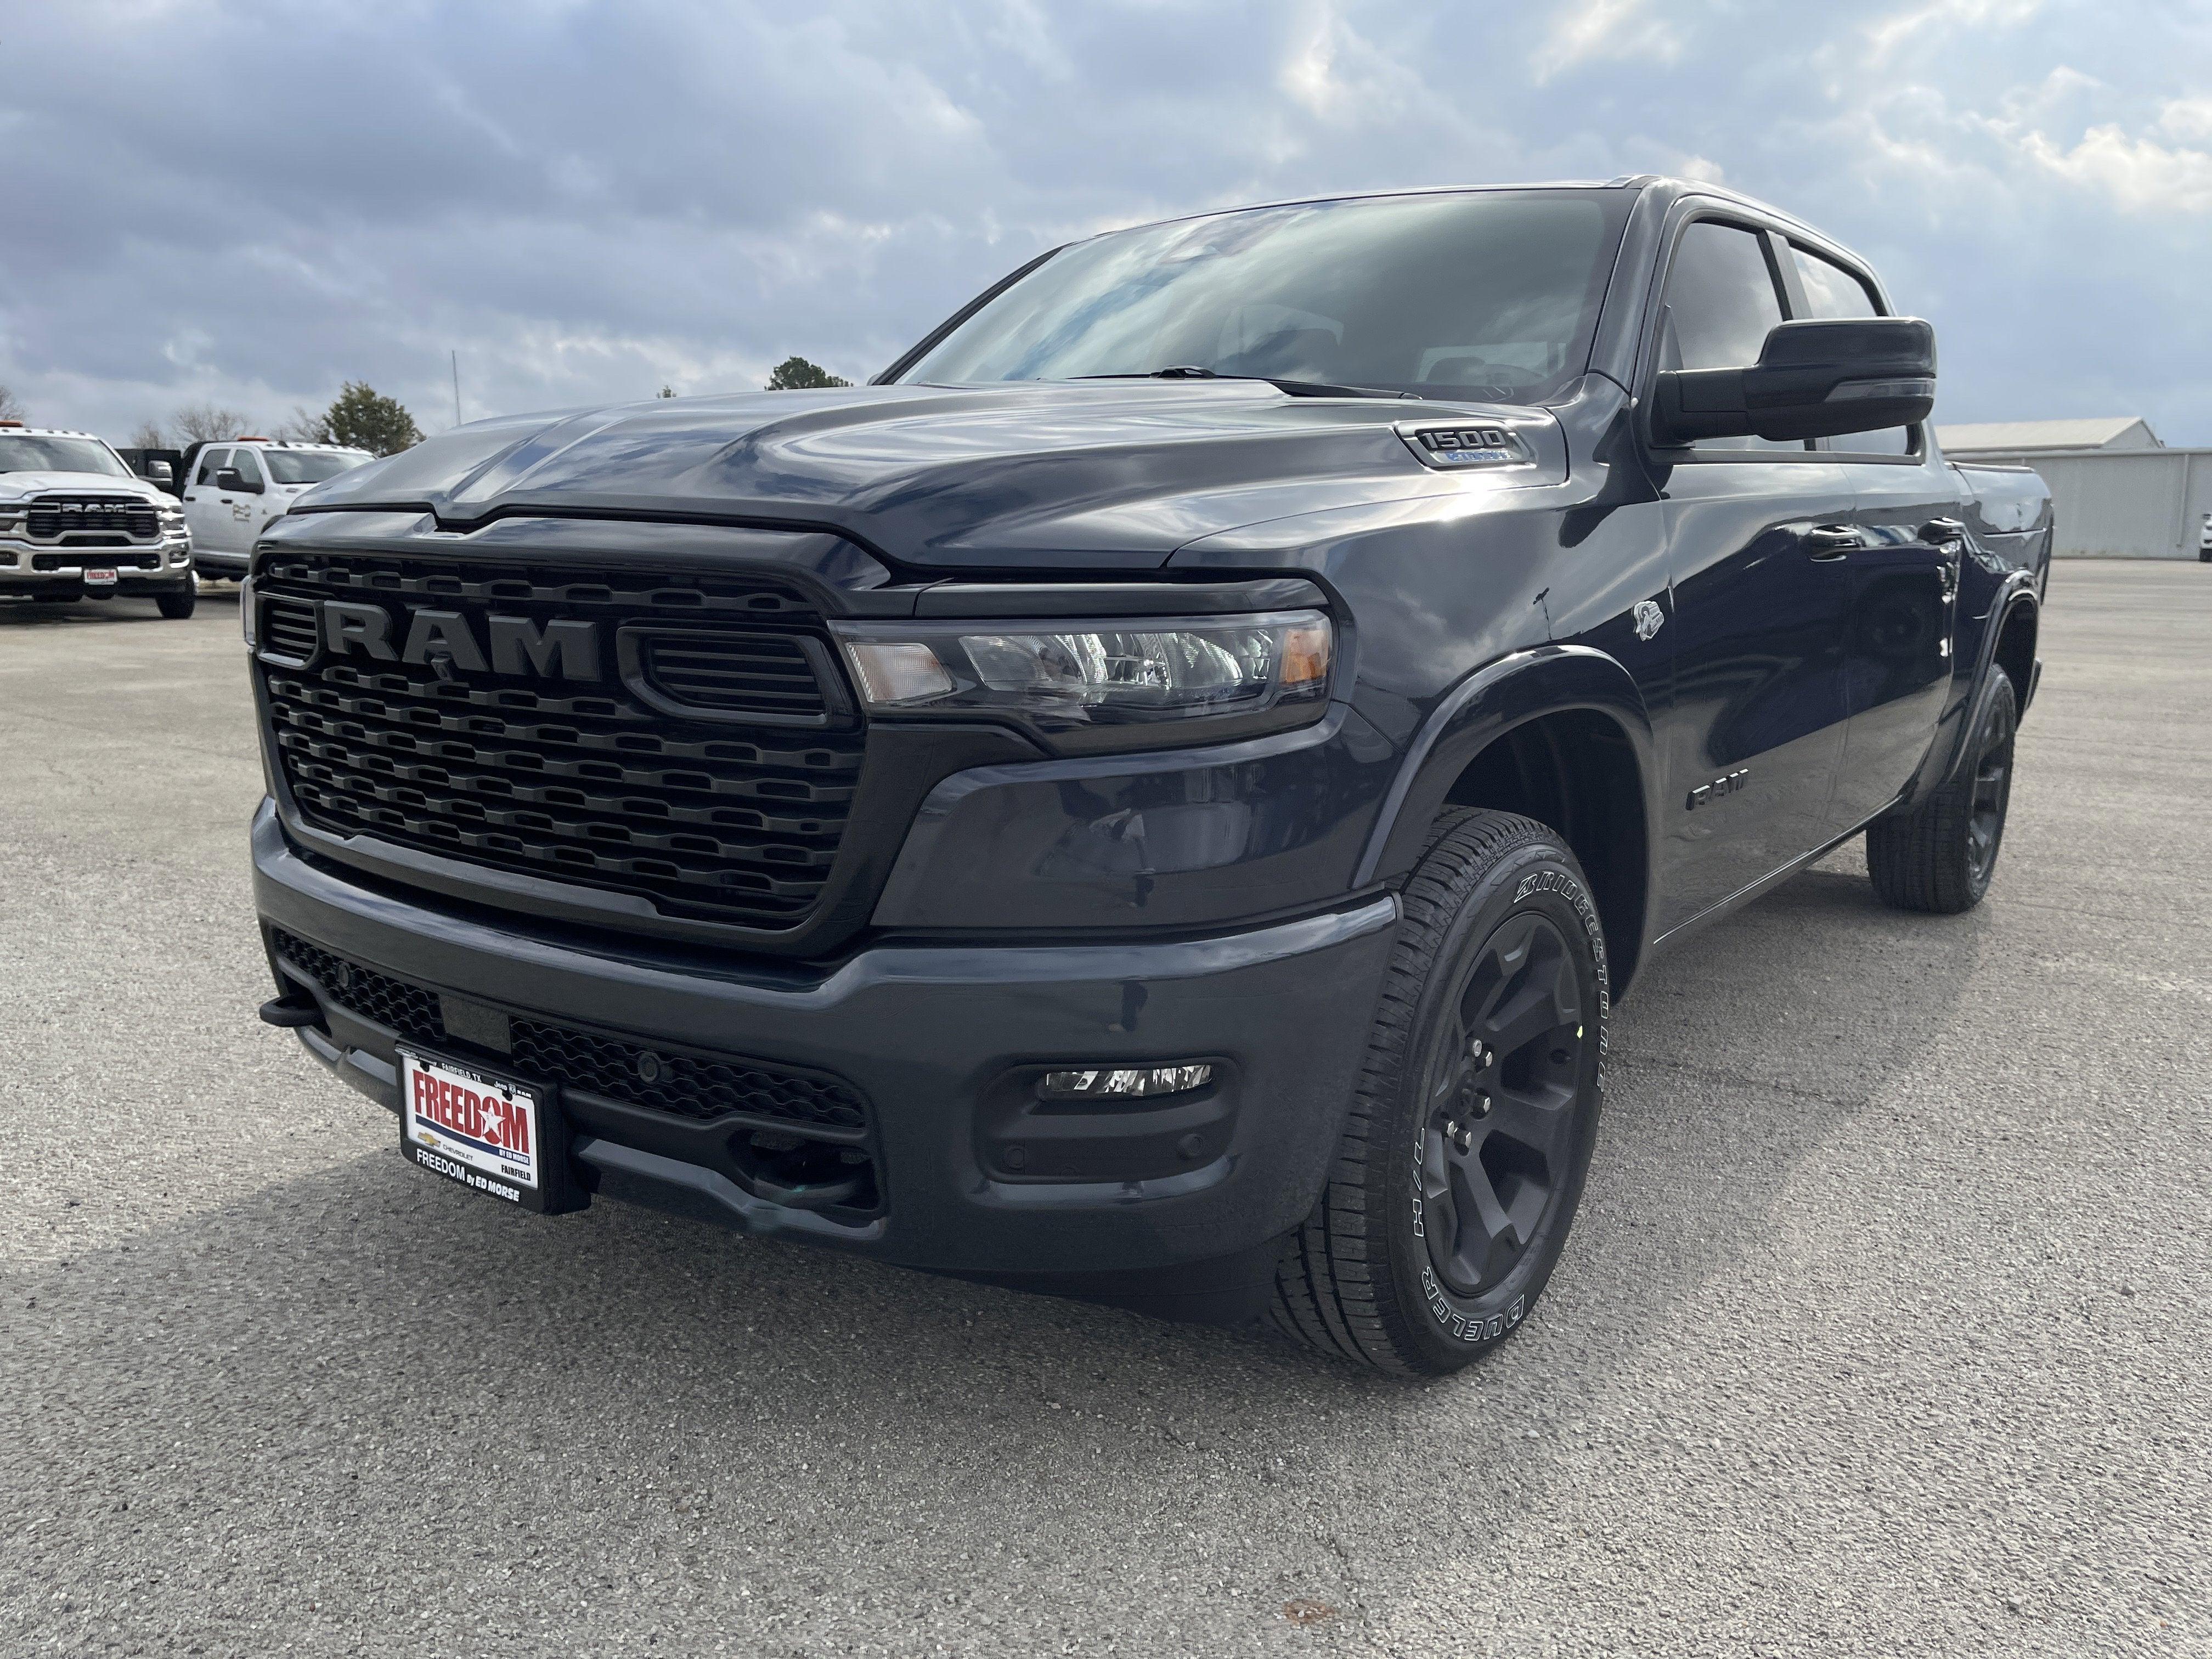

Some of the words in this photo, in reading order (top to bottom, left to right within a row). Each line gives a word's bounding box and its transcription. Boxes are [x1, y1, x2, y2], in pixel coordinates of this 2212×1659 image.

[1423, 430, 1506, 449] 1500
[324, 600, 603, 682] RAM
[1685, 768, 1749, 811] RAM
[1514, 871, 1610, 1093] BRIDGESTONE
[412, 1069, 529, 1154] FREEDOM
[416, 1148, 466, 1181] FREEDOM
[475, 1176, 487, 1190] ED
[487, 1180, 520, 1202] MORSE
[443, 1144, 473, 1161] CHEVROLET
[501, 1164, 531, 1181] FAIRFIELD
[506, 1150, 512, 1160] ED
[512, 1154, 530, 1165] MORSE
[1421, 1266, 1525, 1341] DUELER
